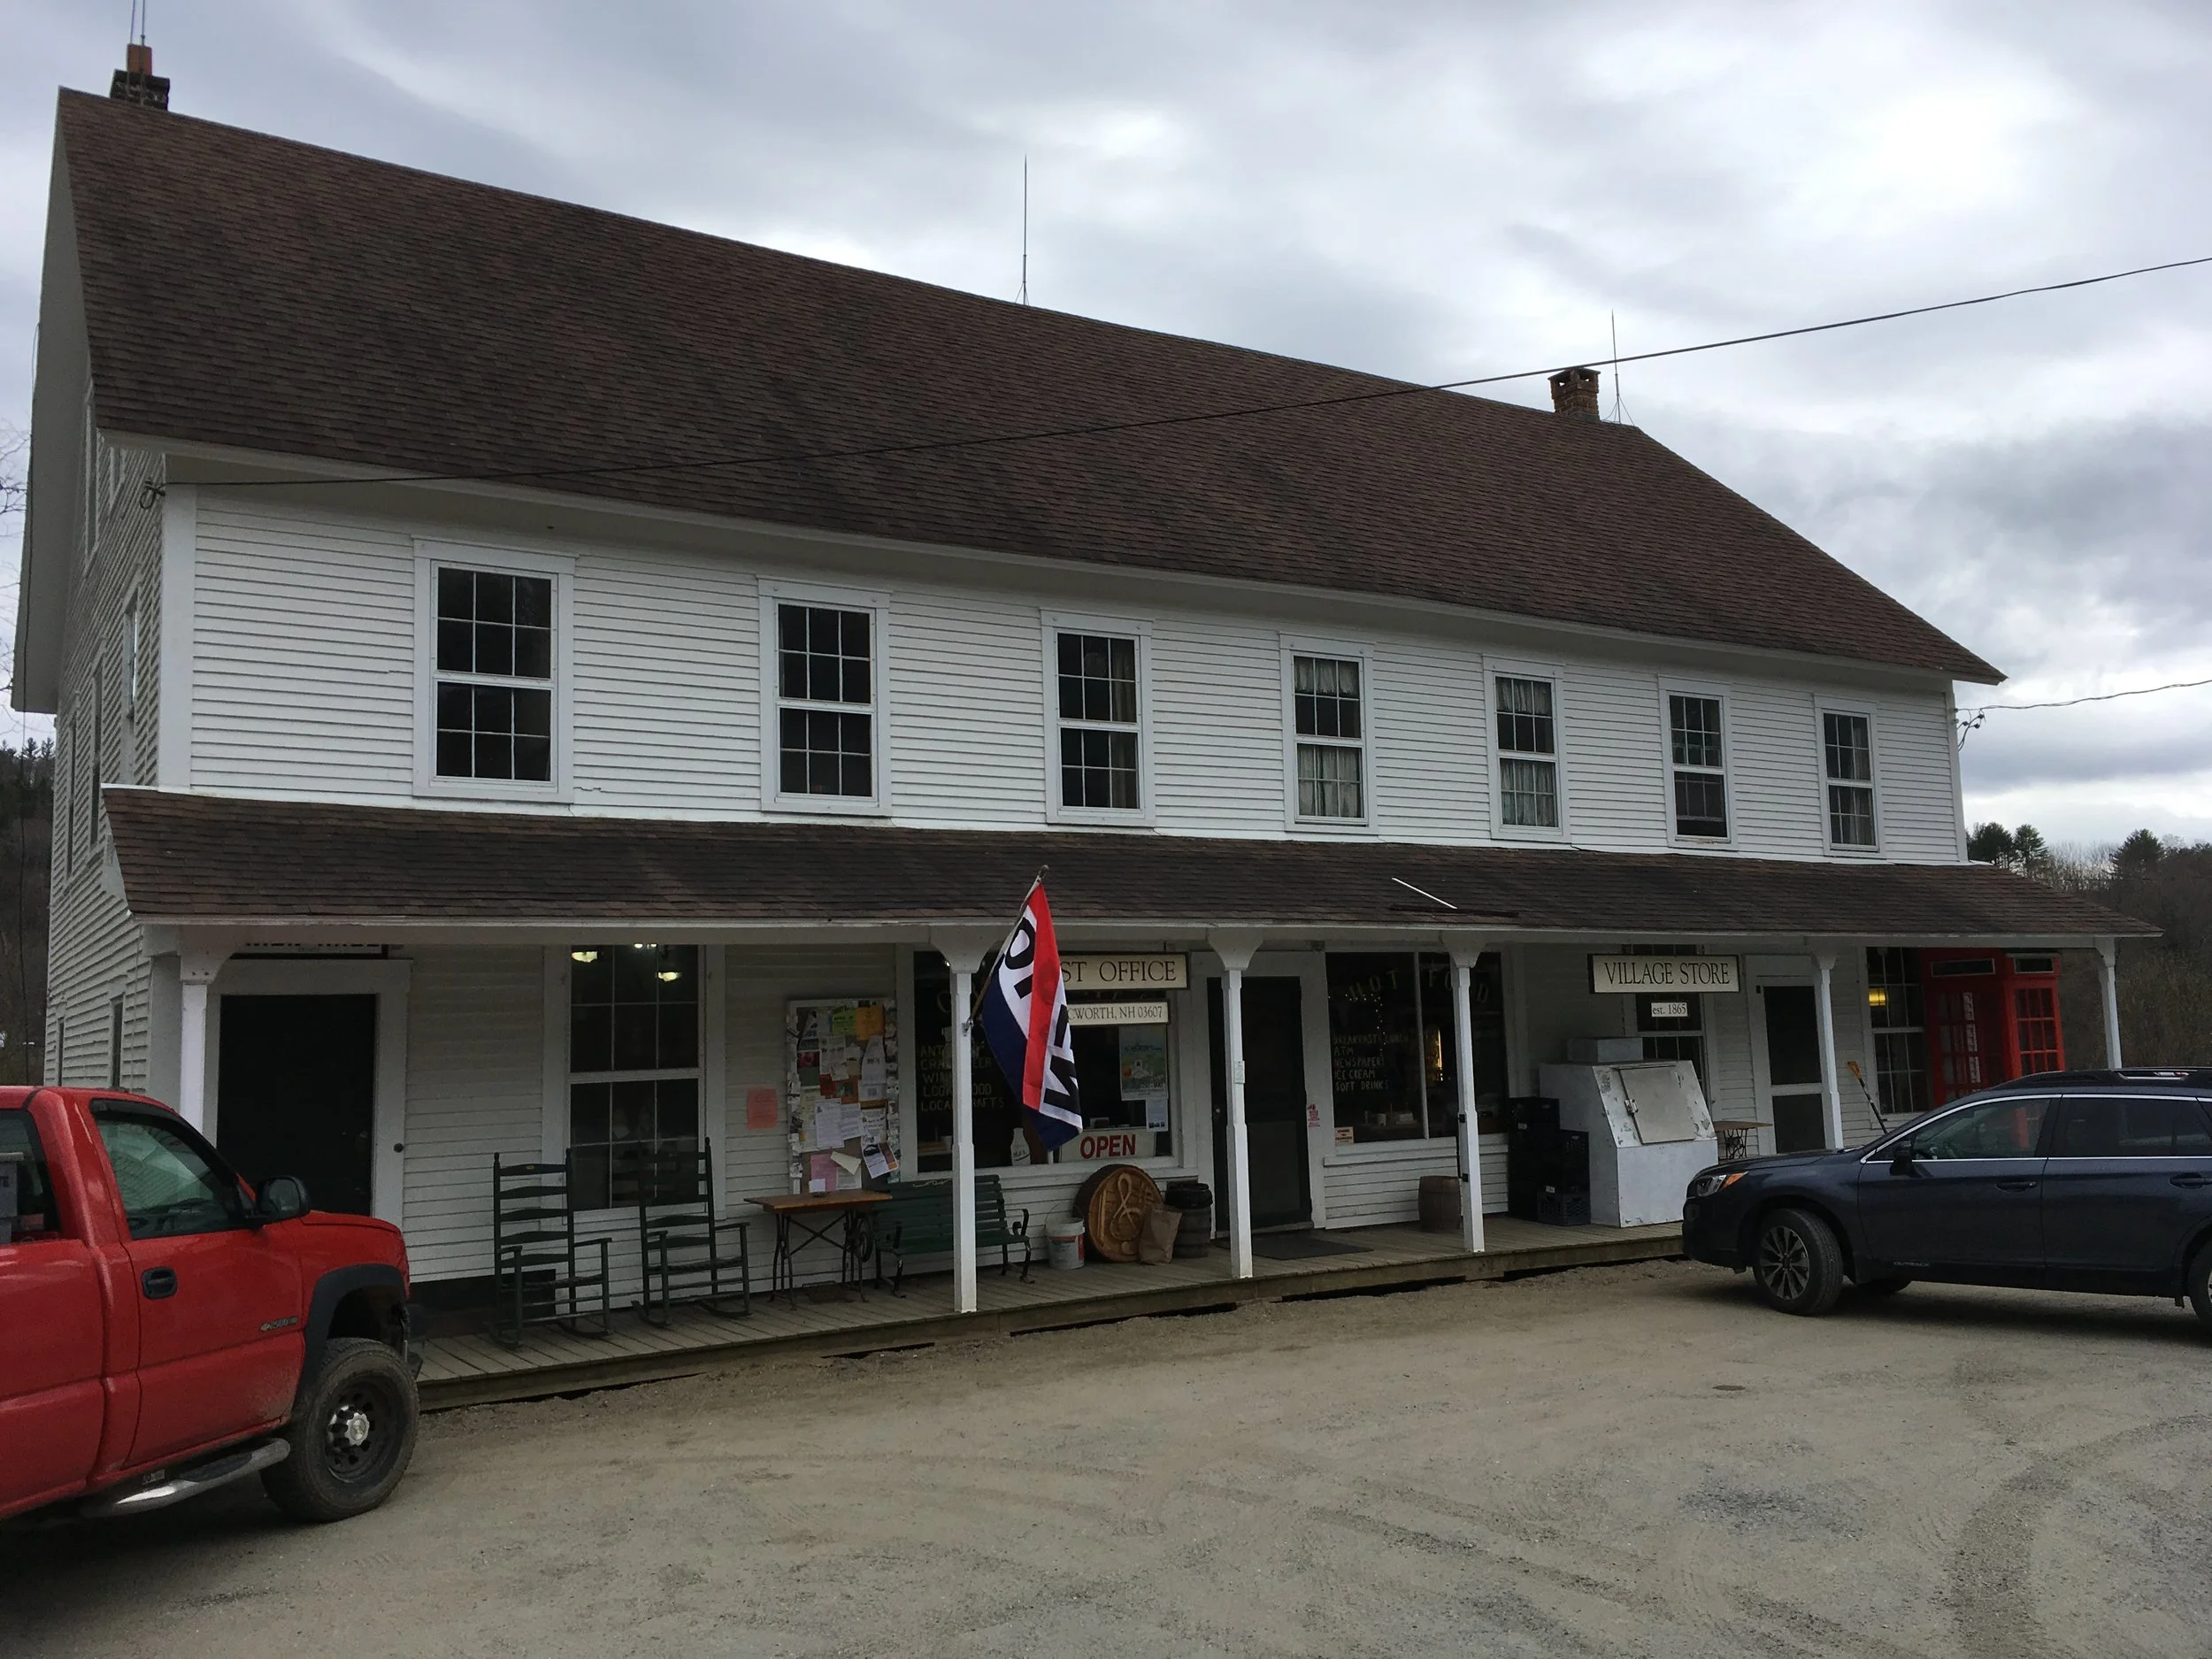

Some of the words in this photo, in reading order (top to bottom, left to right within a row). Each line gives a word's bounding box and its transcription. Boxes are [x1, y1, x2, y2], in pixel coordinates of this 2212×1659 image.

[1060, 961, 1087, 982] ST
[1099, 960, 1177, 982] OFFICE
[1604, 962, 1674, 985] VILLAGE
[1680, 962, 1730, 985] STORE
[1067, 1006, 1118, 1020] CWORTH,
[1119, 1006, 1135, 1018] NH
[1137, 1005, 1163, 1018] 03607
[1652, 1005, 1665, 1015] est.
[1667, 1003, 1686, 1015] 1865
[1333, 1046, 1354, 1056] ATM
[1333, 1056, 1386, 1069] NEWSPAPERS
[1333, 1070, 1347, 1080] ICE
[1348, 1069, 1376, 1080] CREAM
[1334, 1081, 1356, 1092] SOFT
[1360, 1079, 1389, 1091] DRINKS
[1079, 1133, 1137, 1160] OPEN
